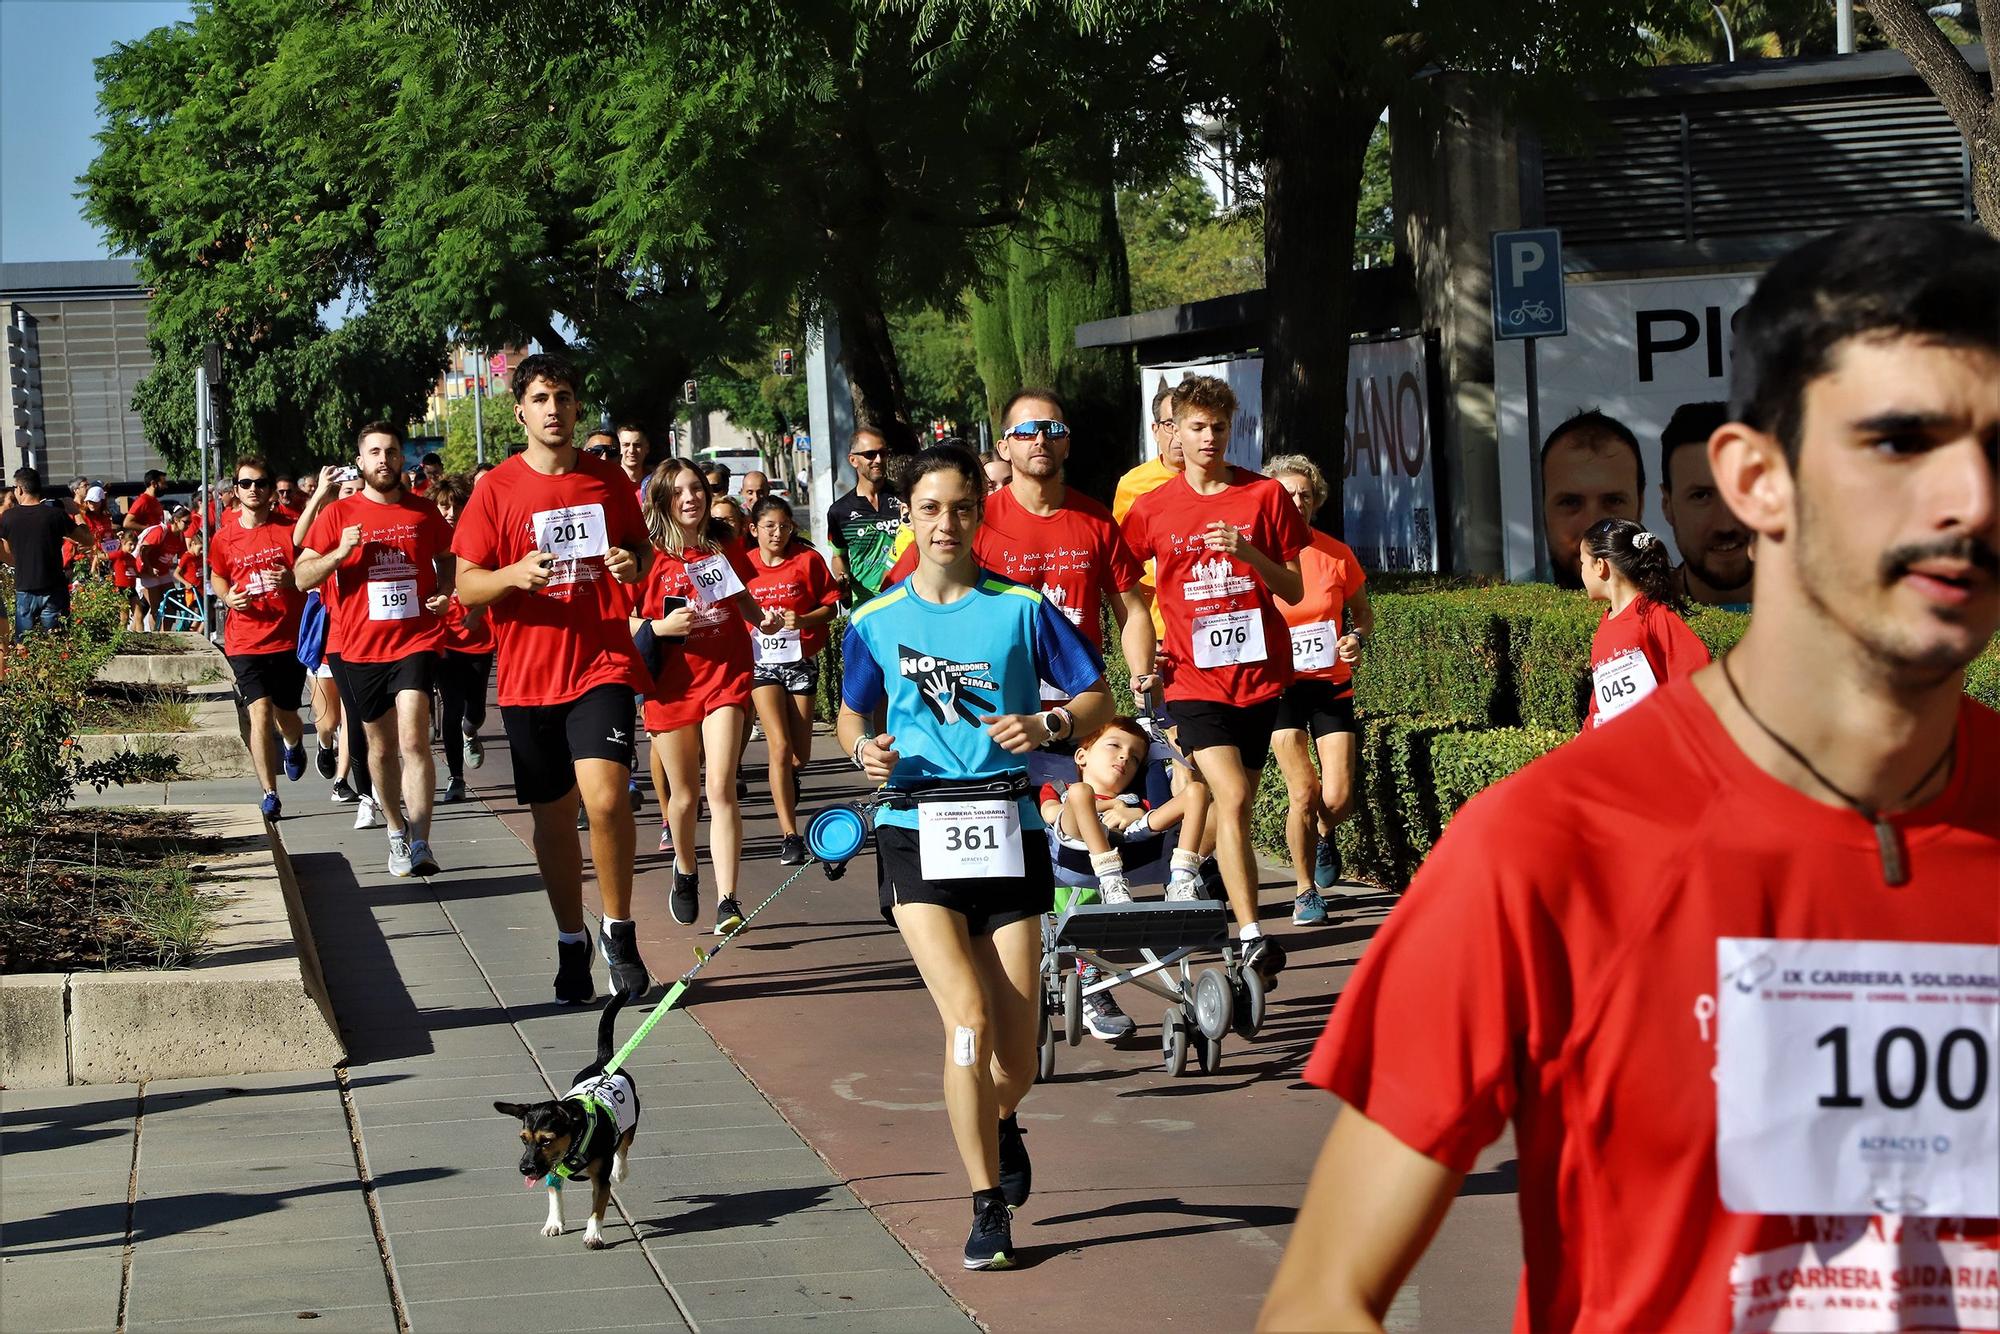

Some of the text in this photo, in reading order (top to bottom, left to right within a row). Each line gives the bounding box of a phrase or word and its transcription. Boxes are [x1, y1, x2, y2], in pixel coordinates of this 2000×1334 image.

[1511, 241, 1545, 288] P
[553, 522, 589, 544] 201
[696, 568, 723, 588] 080
[382, 592, 408, 607] 199
[762, 637, 788, 650] 092
[1210, 626, 1247, 647] 076
[1292, 637, 1324, 656] 375
[900, 656, 936, 676] NO
[945, 662, 989, 673] ABANDONES
[1601, 675, 1636, 703] 045
[945, 825, 999, 851] 361
[1782, 970, 1803, 983] IX
[1810, 971, 1904, 985] CARRERA
[1816, 1025, 1990, 1112] 100
[1777, 1267, 1883, 1292] CARRERA
